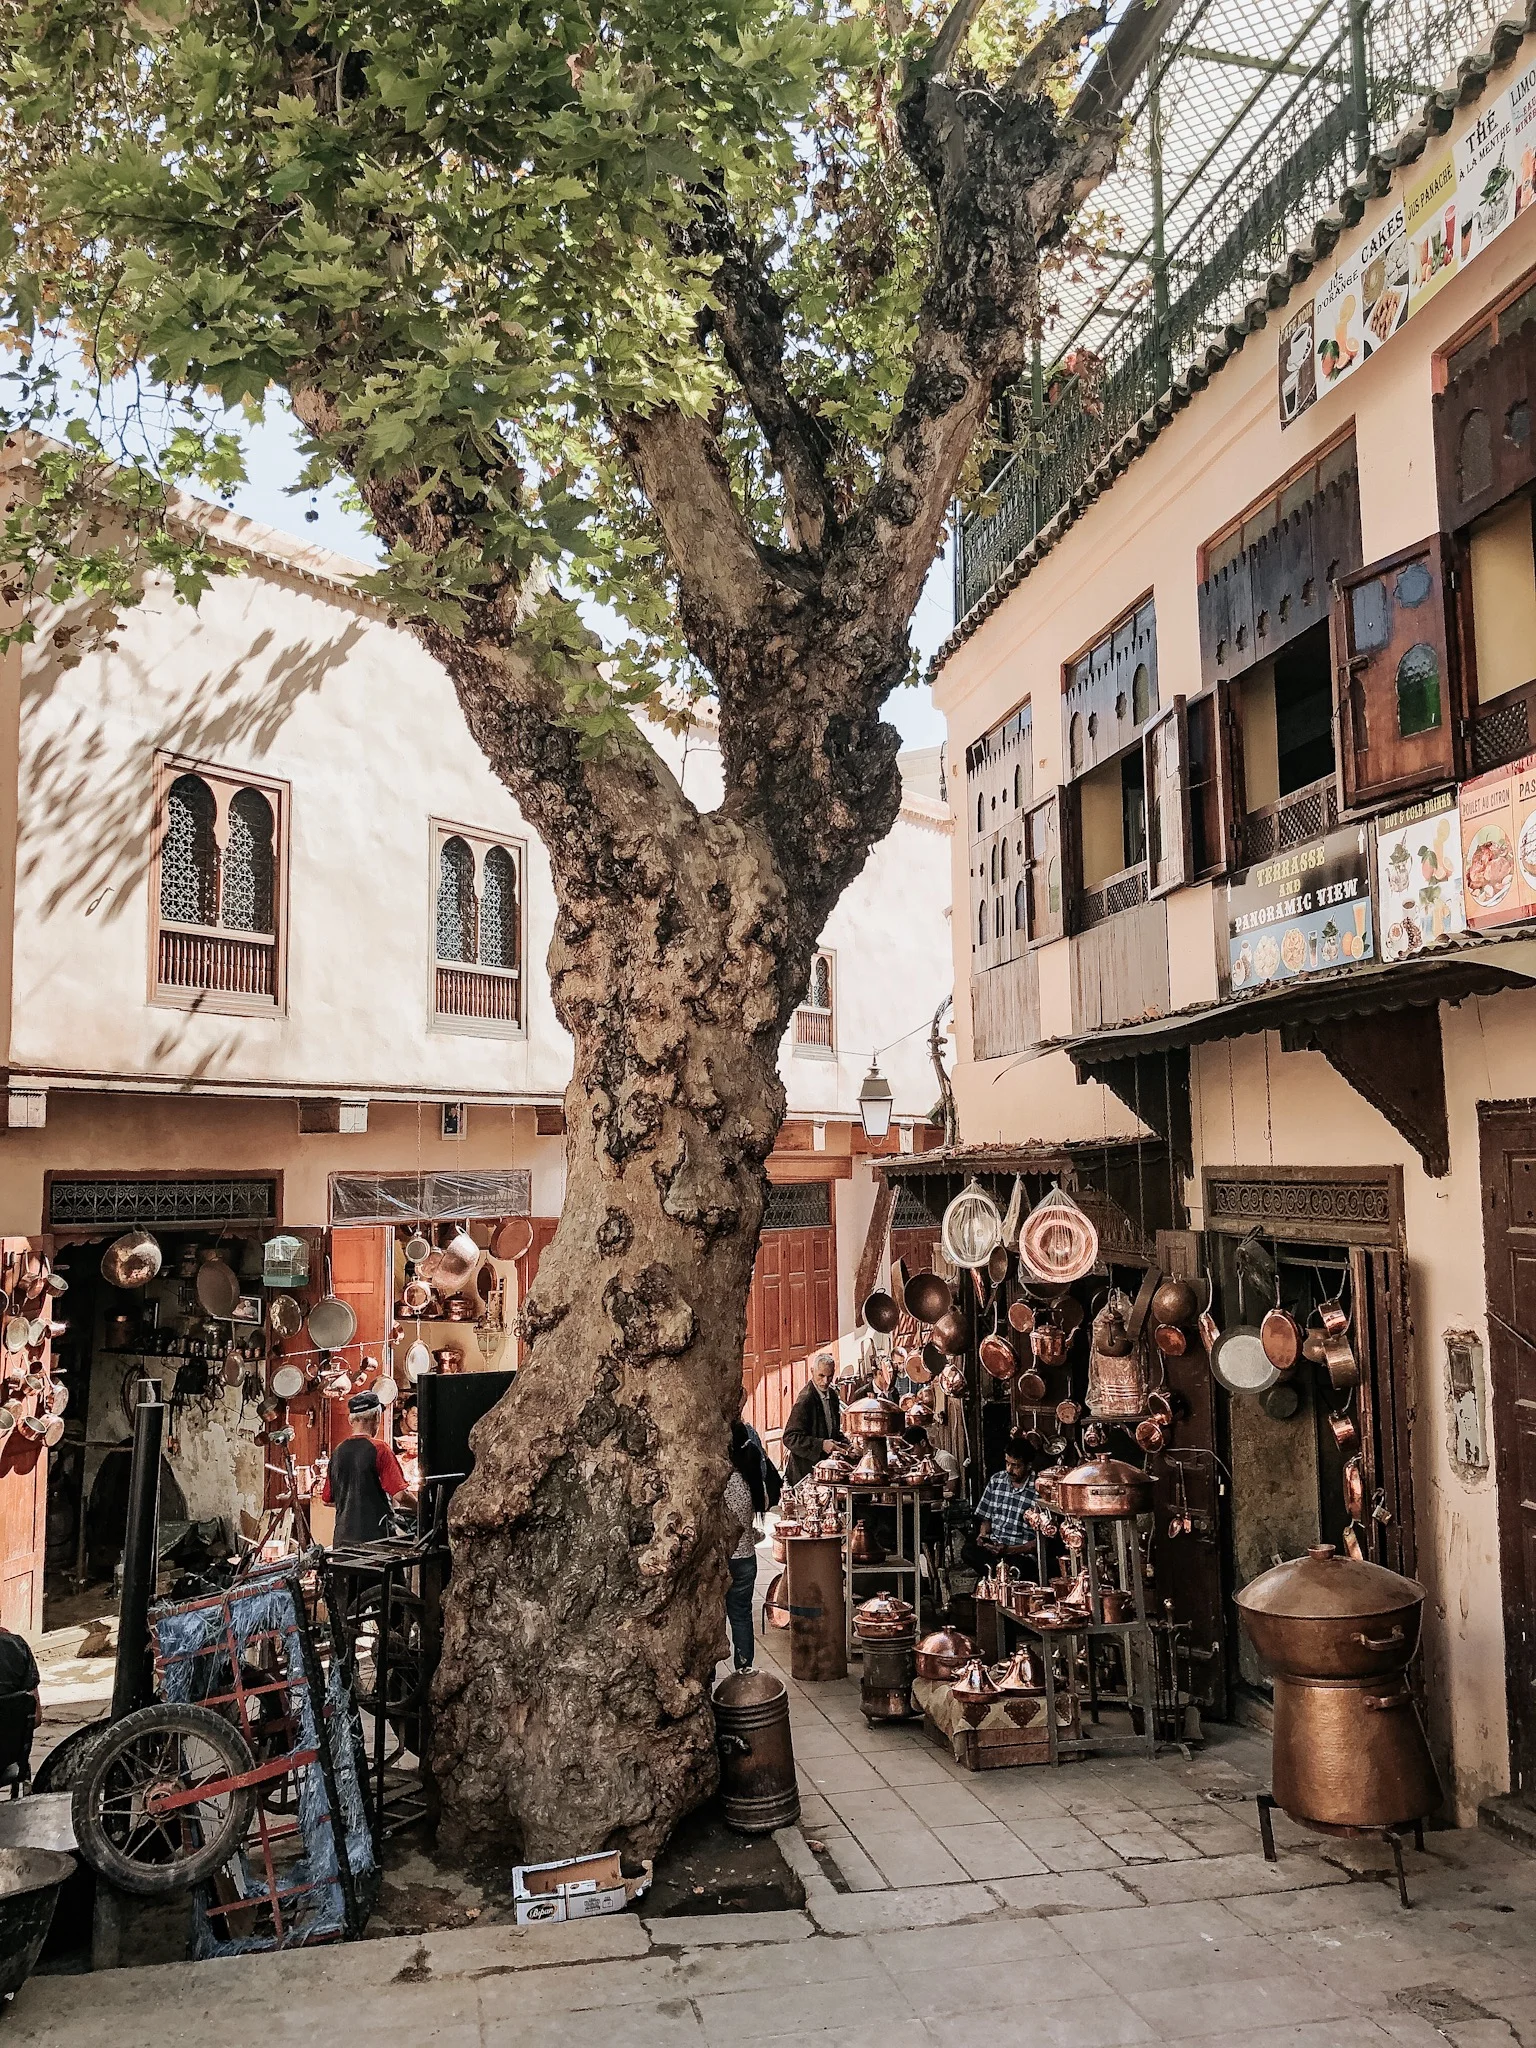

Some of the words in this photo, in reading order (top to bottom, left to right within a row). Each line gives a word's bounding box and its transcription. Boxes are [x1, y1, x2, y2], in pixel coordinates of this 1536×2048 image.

[1511, 70, 1536, 107] LIMO
[1466, 109, 1498, 154] THÉ
[1466, 158, 1477, 174] LA
[1480, 122, 1511, 162] MENTHE
[1408, 200, 1420, 221] JUS
[1420, 161, 1453, 208] PANACHÉ
[1361, 210, 1404, 264] CAKES
[1317, 269, 1359, 316] D'ORANGE
[1328, 272, 1343, 293] JUS
[1462, 798, 1481, 816] POULET
[1482, 796, 1489, 811] AU
[1491, 788, 1510, 806] CITRON
[1519, 778, 1536, 798] PAS
[1384, 812, 1398, 829] HOT
[1400, 810, 1404, 824] &
[1406, 803, 1423, 821] COLD
[1256, 845, 1325, 887] TERRASSE
[1234, 892, 1312, 933] PANORAMIC
[1315, 877, 1359, 907] VIEW
[1279, 878, 1301, 898] AND
